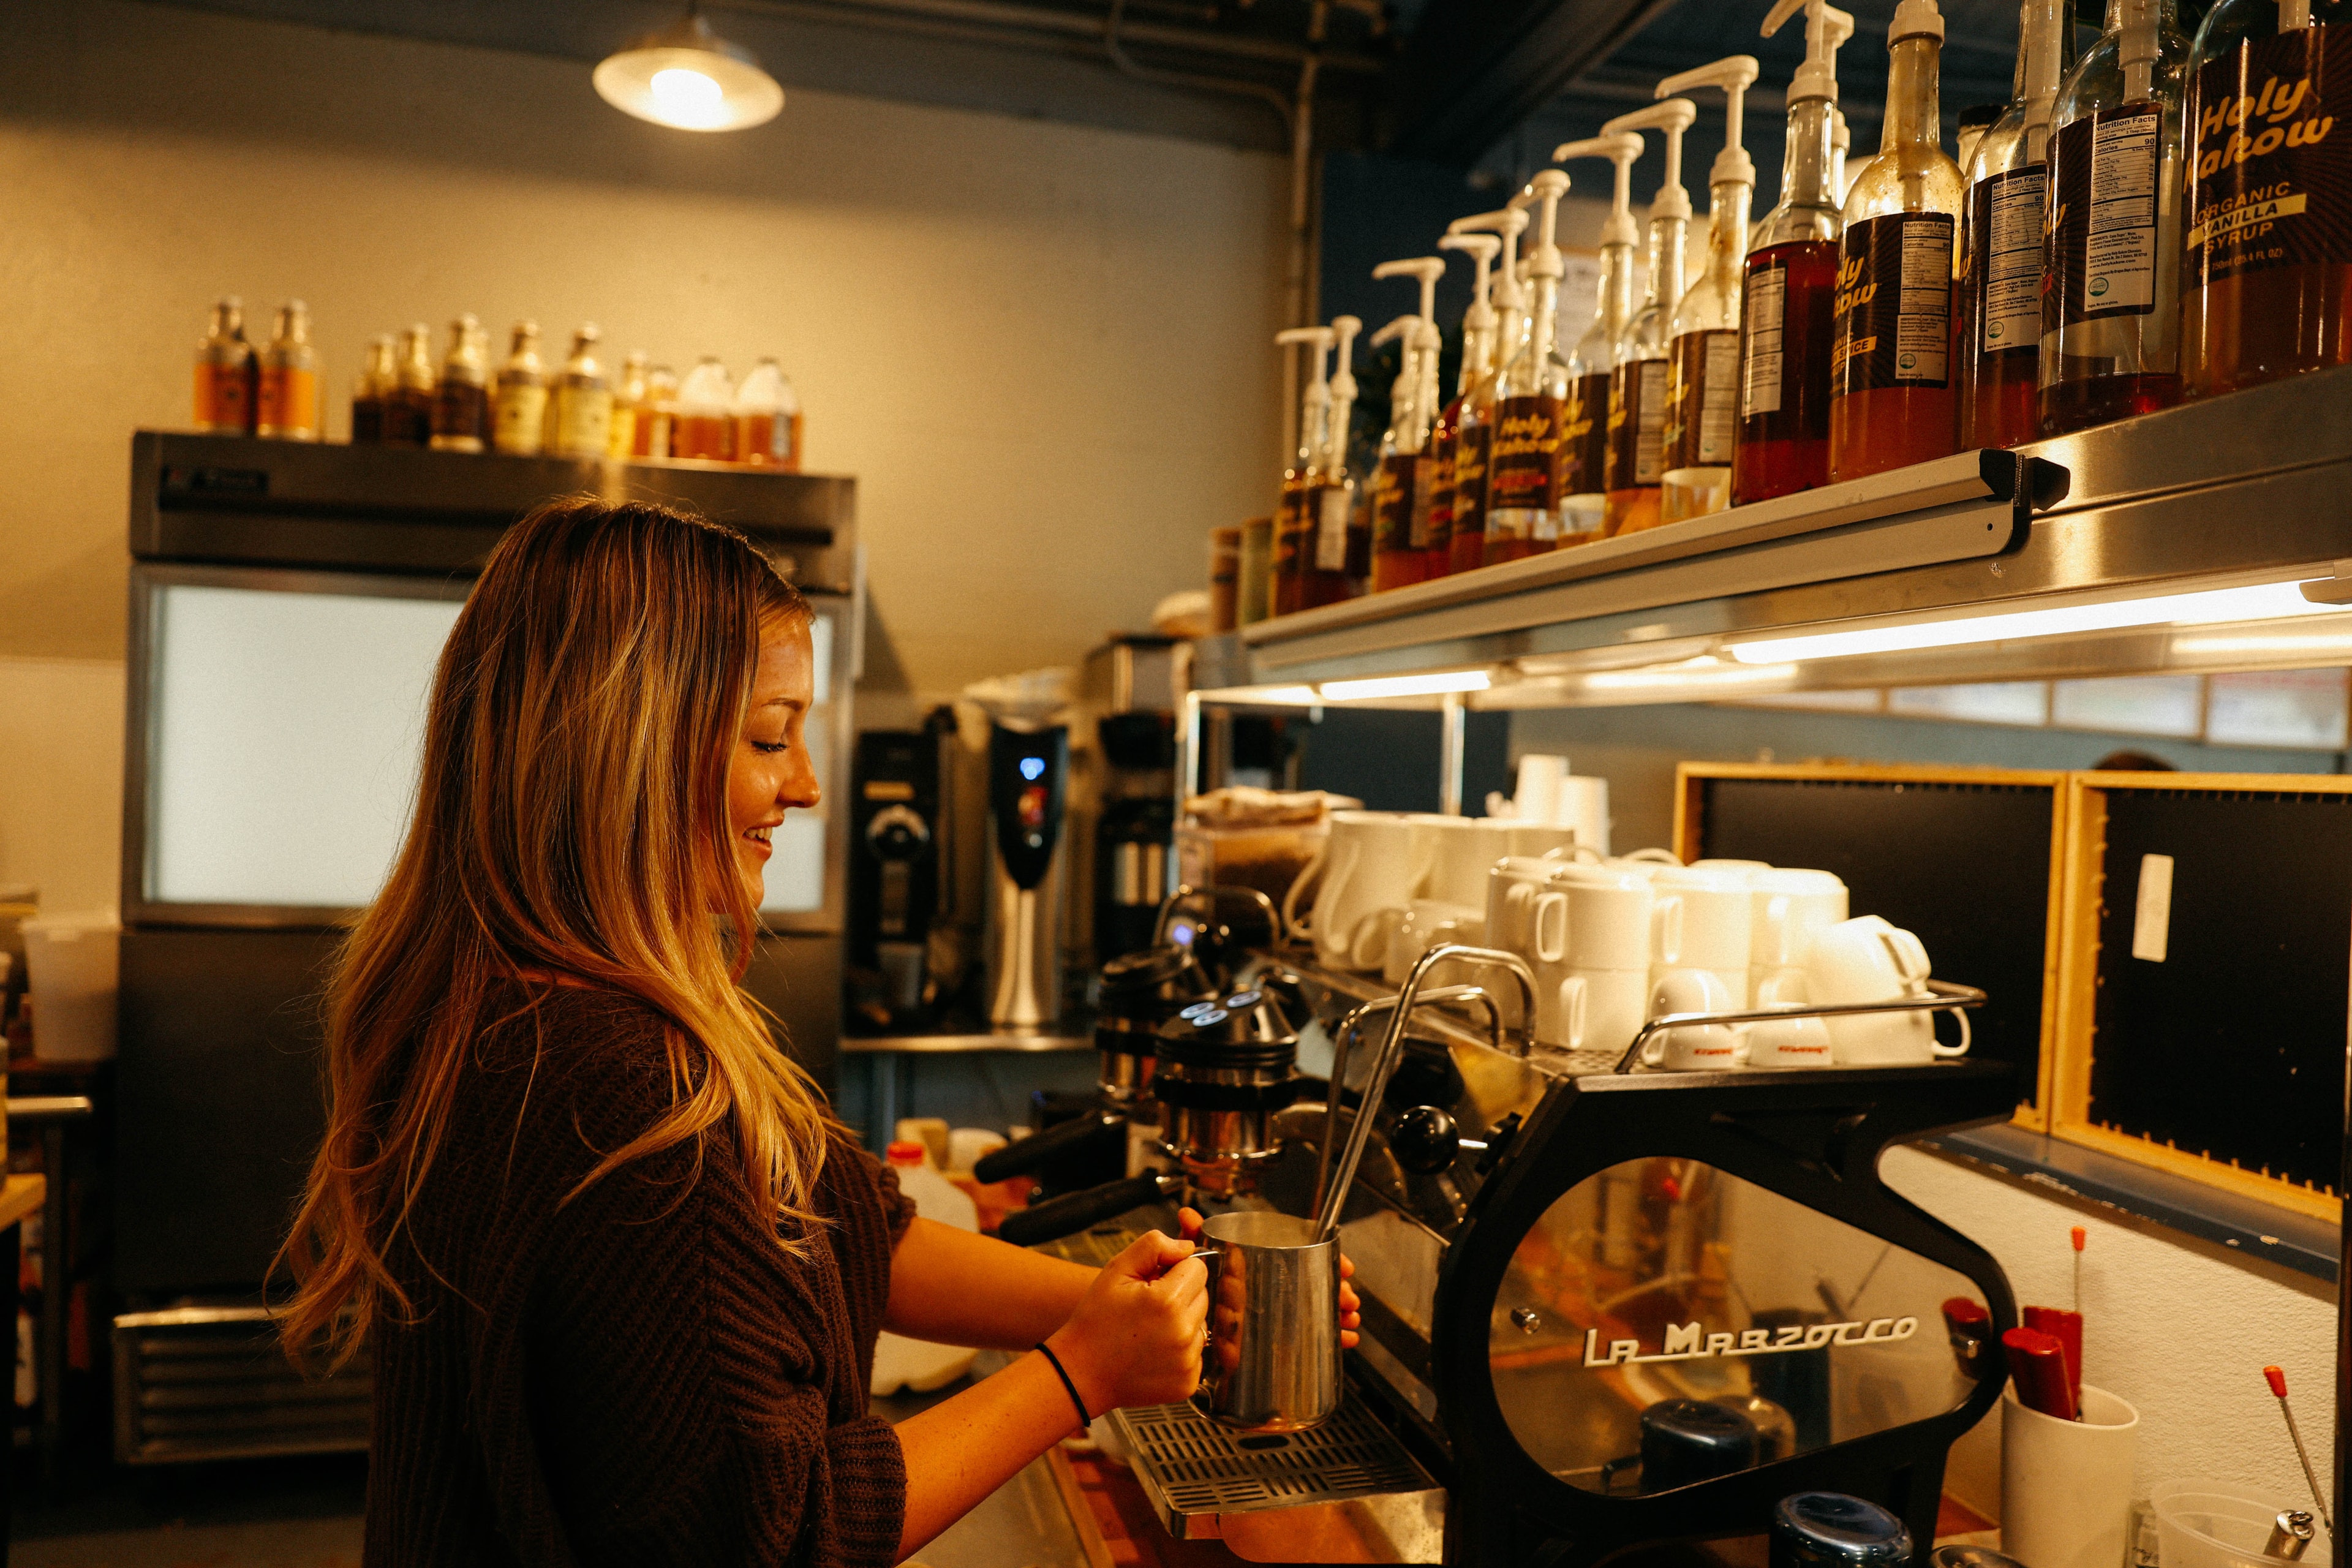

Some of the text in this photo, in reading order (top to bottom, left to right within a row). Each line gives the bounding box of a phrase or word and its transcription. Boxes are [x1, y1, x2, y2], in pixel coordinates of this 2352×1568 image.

[2097, 120, 2130, 131] Nutrition
[2198, 76, 2309, 145] Holy
[2095, 145, 2118, 154] Calories
[2183, 116, 2333, 194] Kakow
[1992, 202, 2012, 211] Calories
[2197, 181, 2290, 224] ORGANIC
[2203, 203, 2278, 237] VANILLA
[2206, 222, 2274, 254] SYRUP
[1835, 256, 1864, 292] oly
